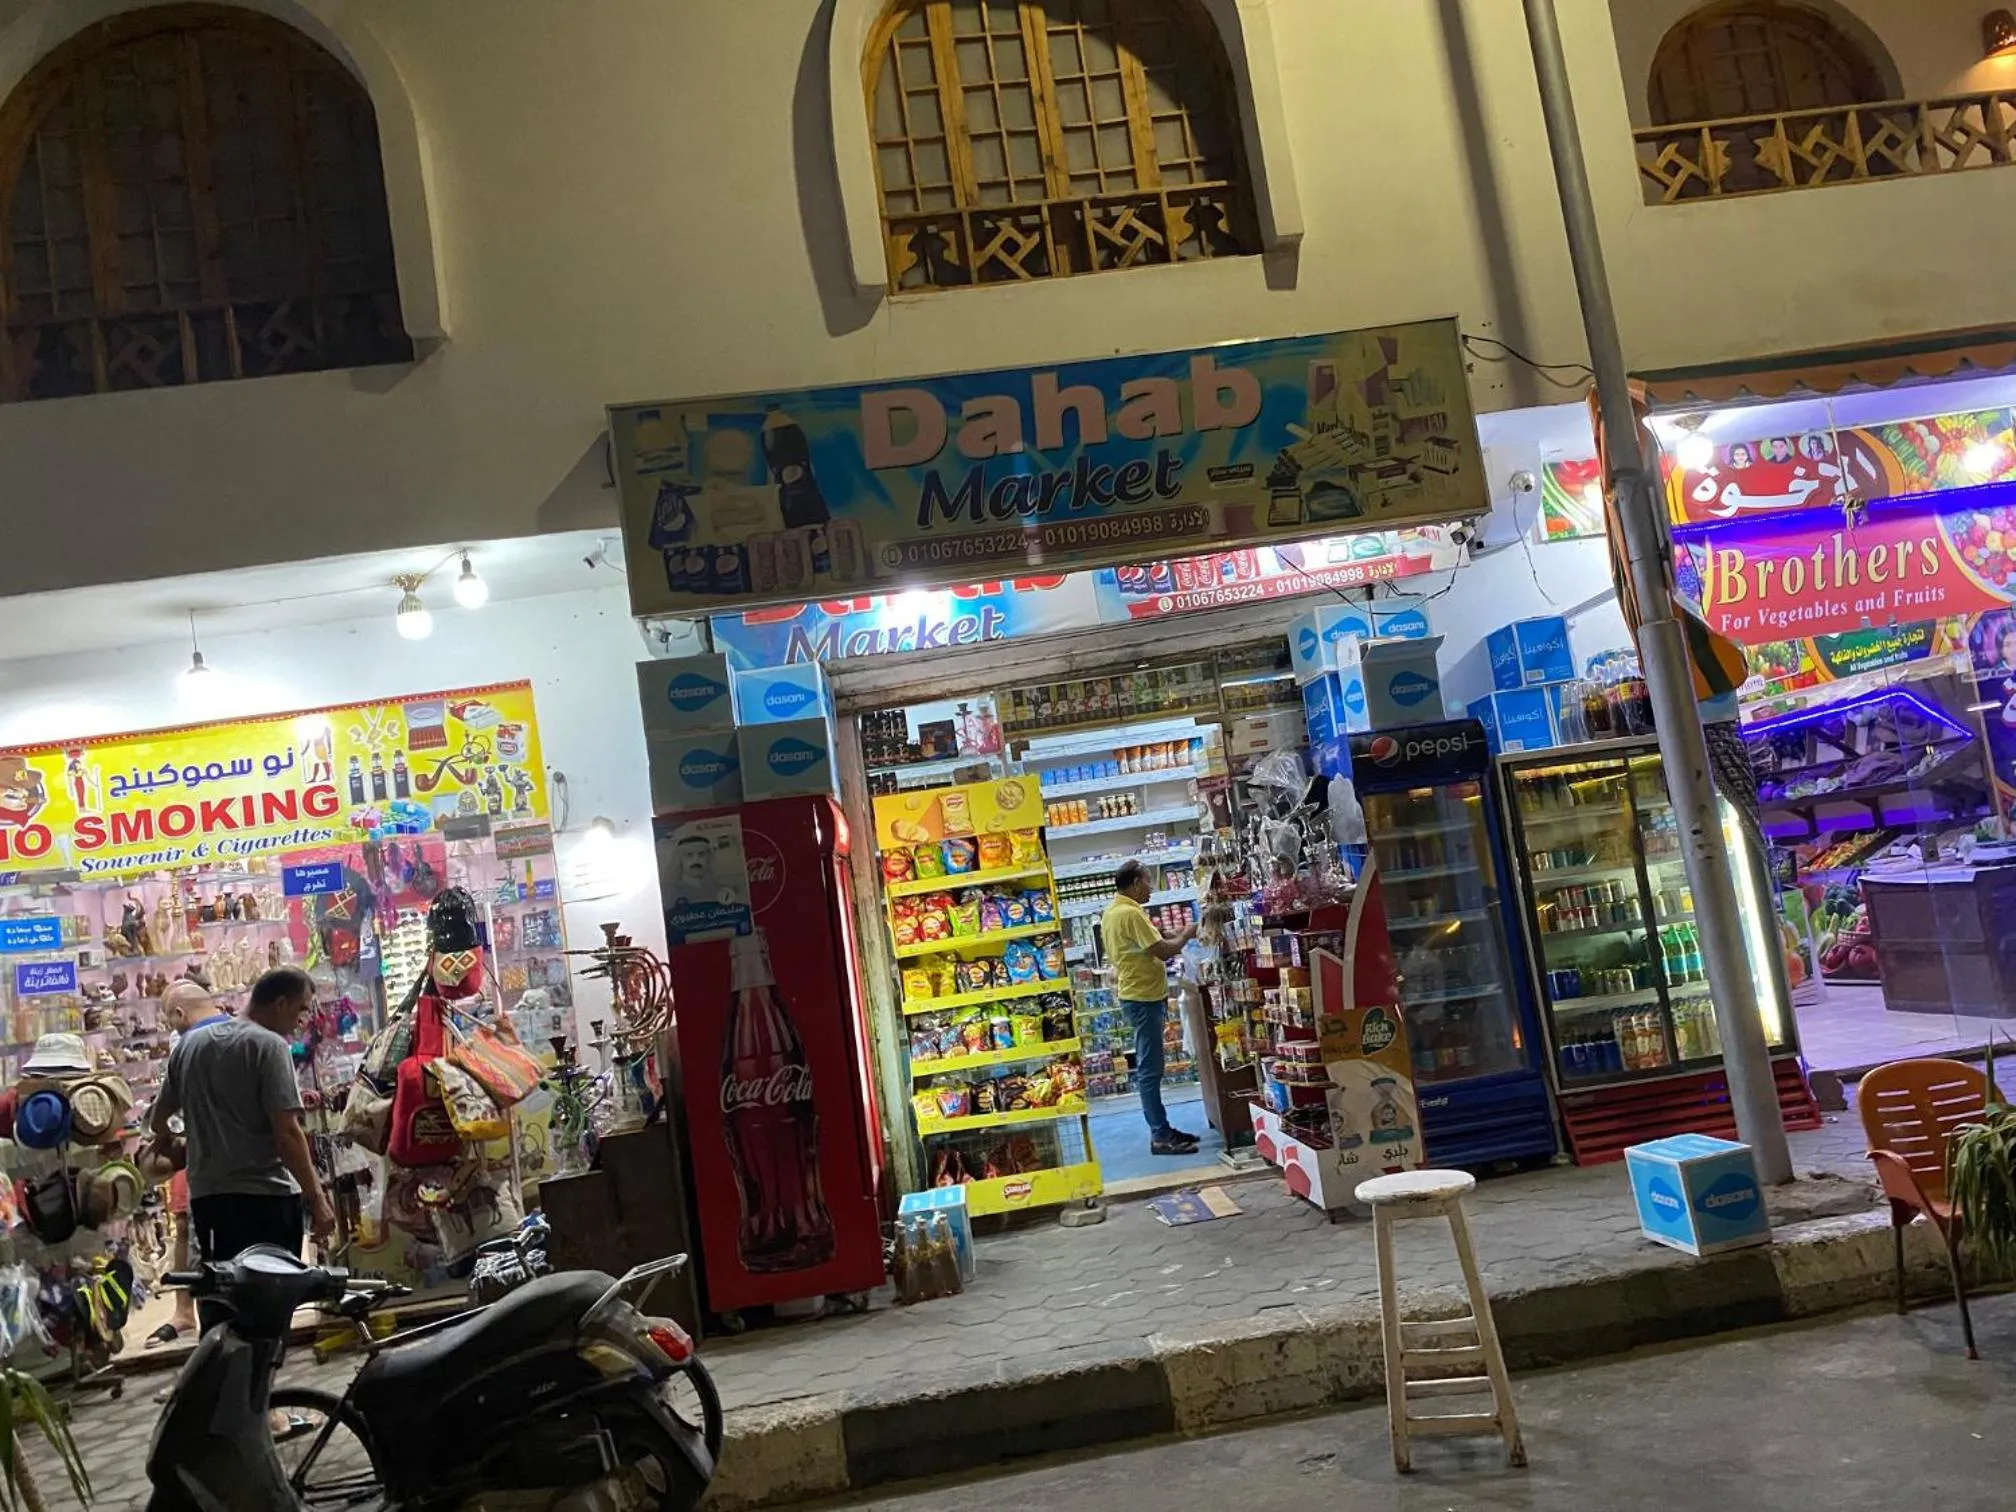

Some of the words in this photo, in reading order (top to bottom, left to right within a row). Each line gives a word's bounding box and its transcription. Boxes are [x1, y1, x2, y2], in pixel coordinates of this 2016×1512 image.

[861, 353, 1262, 470] Dahab
[917, 449, 1184, 529] Market
[908, 533, 1029, 562] 01067653224
[1045, 516, 1163, 548] 01019084998
[1176, 584, 1265, 609] 01067653224
[1277, 567, 1364, 594] 01019084998
[1716, 532, 1942, 606] Brothers
[1388, 620, 1425, 635] dasani
[1720, 613, 1751, 633] For
[1758, 599, 1849, 631] Vegetables
[1854, 595, 1886, 613] and
[1893, 585, 1946, 608] Fruits
[784, 606, 1005, 664] Market
[670, 684, 715, 699] dasani
[766, 693, 805, 707] dasani
[264, 747, 295, 778] نو
[770, 749, 814, 764] dasani
[1405, 731, 1468, 762] pepsi
[108, 757, 254, 799] سموكينج
[73, 783, 340, 851] SMOKING
[79, 845, 186, 873] Souvenir
[193, 841, 208, 857] &
[216, 825, 333, 857] Cigarettes
[719, 1063, 813, 1114] Coca-Cola
[1705, 1187, 1754, 1209] dasani
